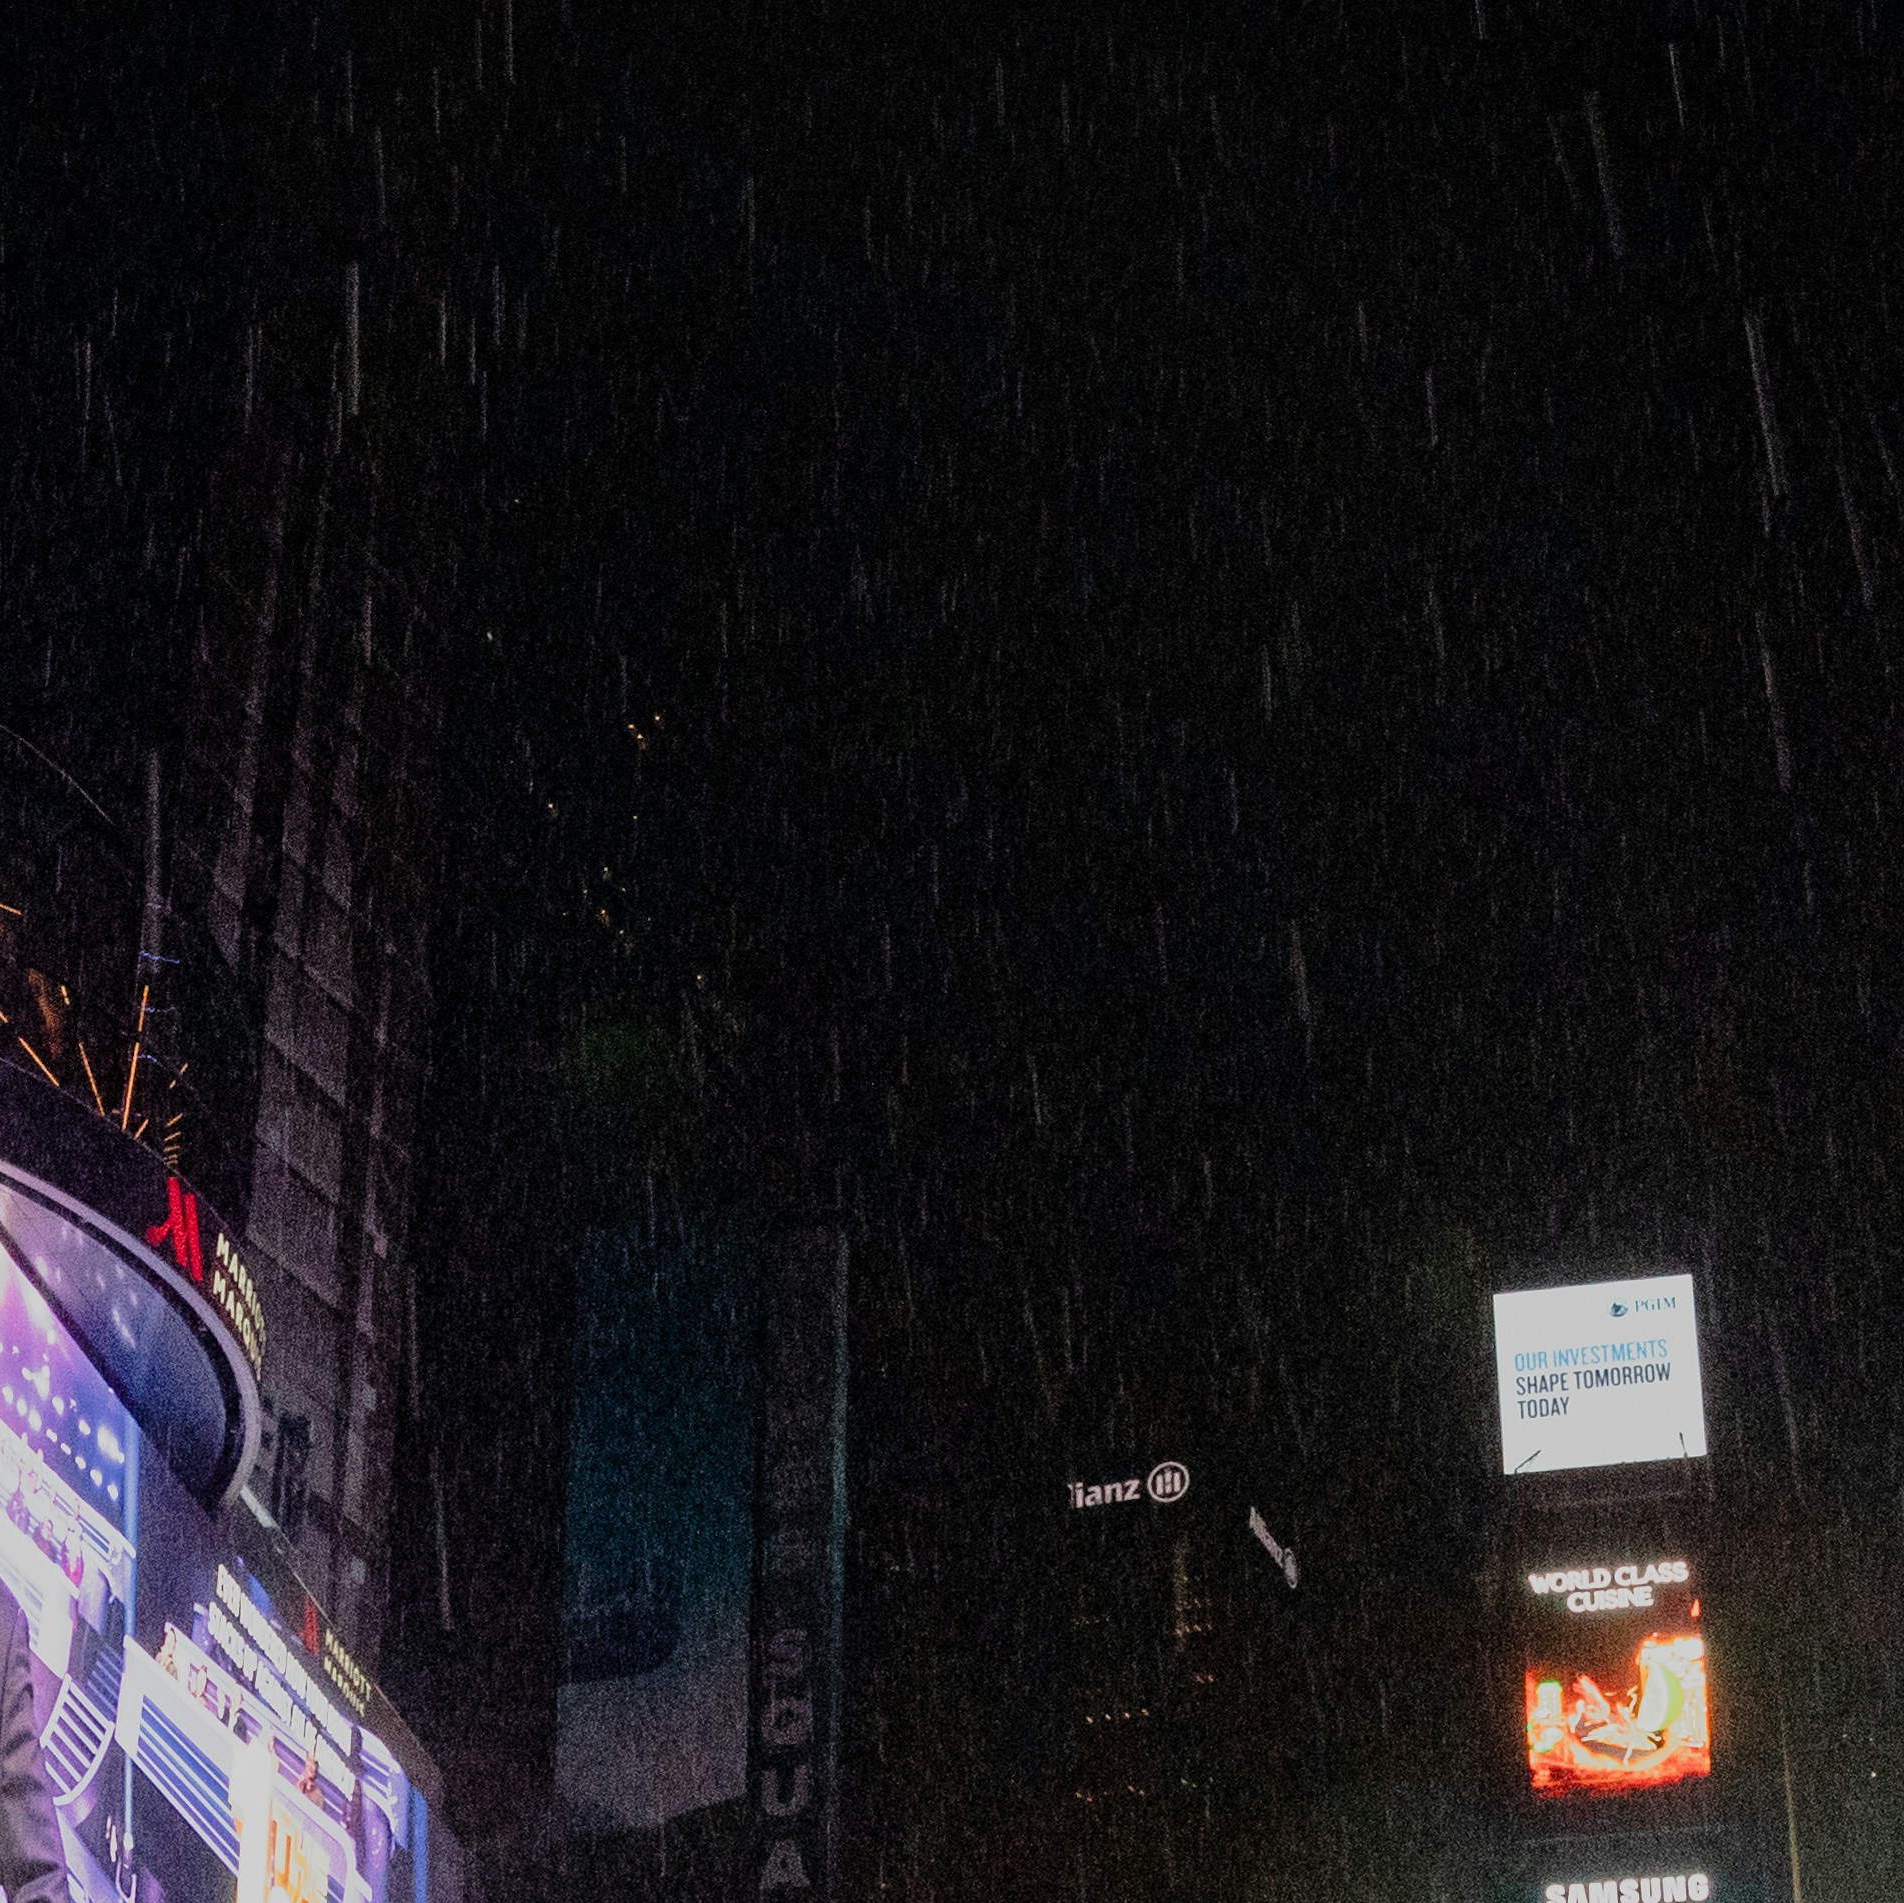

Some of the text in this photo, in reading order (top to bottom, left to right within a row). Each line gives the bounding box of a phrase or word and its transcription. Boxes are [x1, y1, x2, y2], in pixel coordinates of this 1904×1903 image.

[1514, 1339, 1668, 1372] OUR INVESTMENTS
[1516, 1362, 1671, 1396] SHAPE TOMORROW
[1518, 1397, 1570, 1420] TODAY
[1528, 1561, 1689, 1594] WORLD CLASS
[1567, 1586, 1654, 1613] CUISINE
